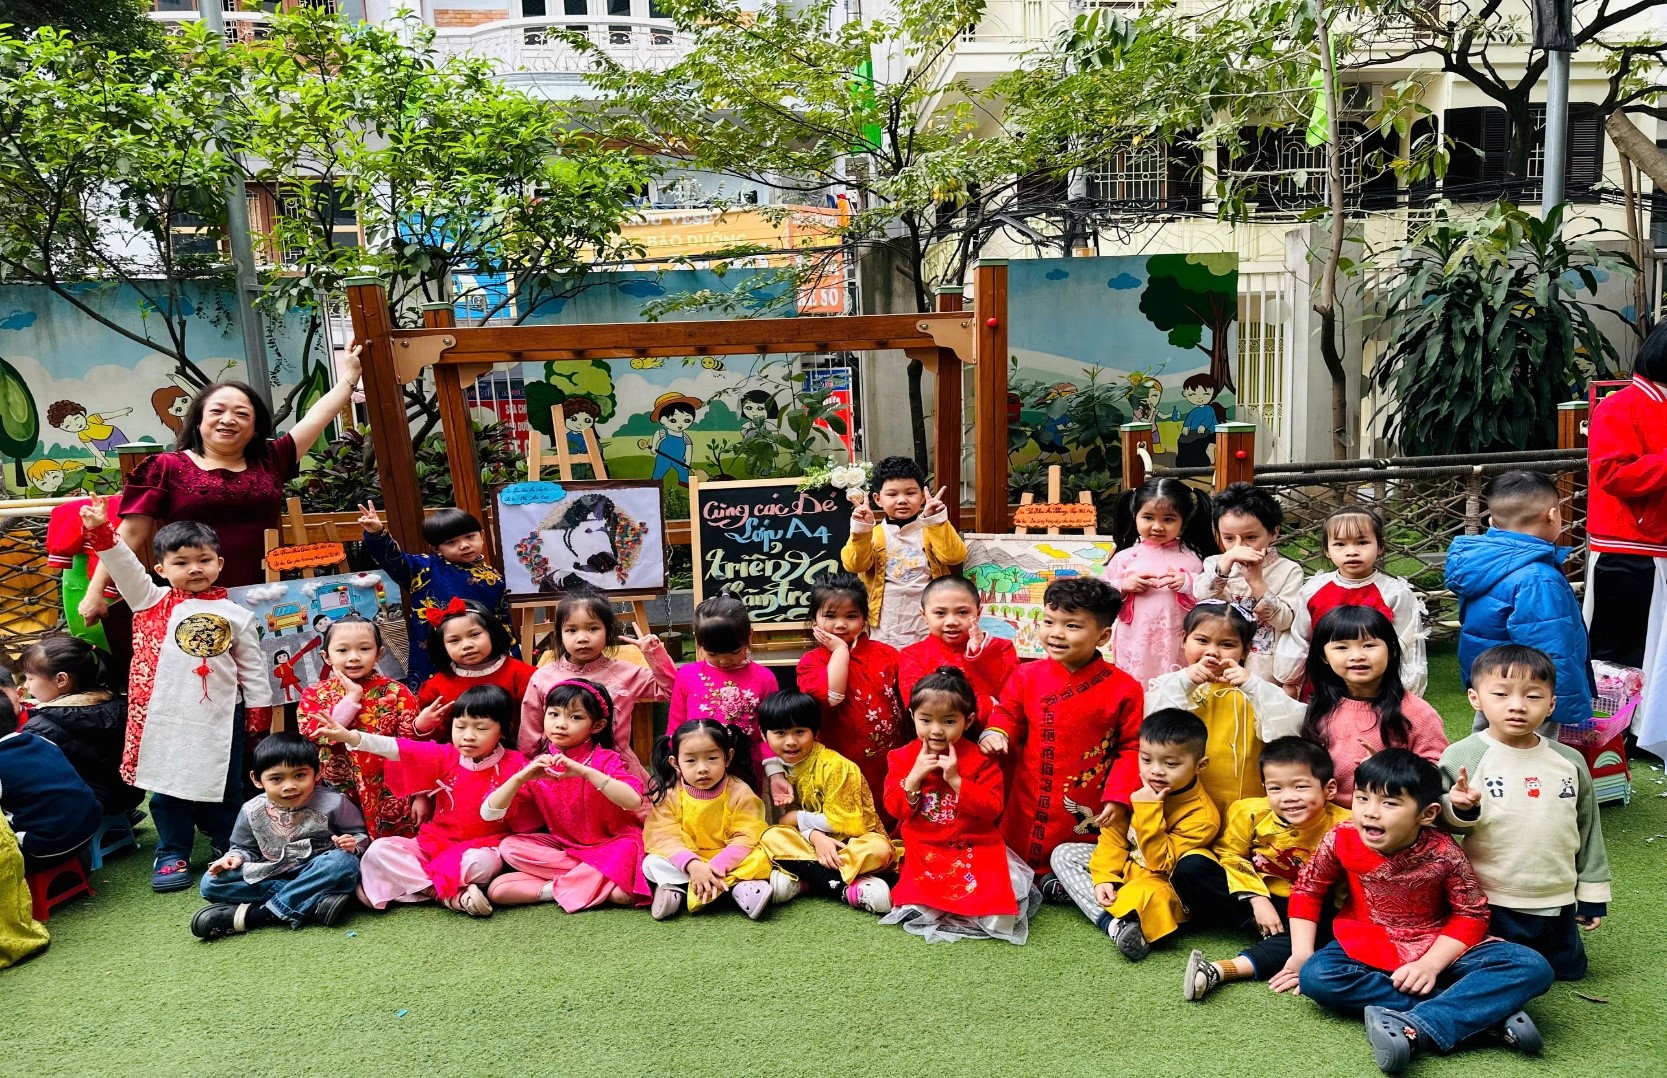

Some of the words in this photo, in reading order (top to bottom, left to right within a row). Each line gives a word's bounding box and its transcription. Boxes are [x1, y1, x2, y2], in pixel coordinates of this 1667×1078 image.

[754, 493, 790, 516] các
[724, 517, 784, 553] Lớp
[786, 517, 834, 544] A4
